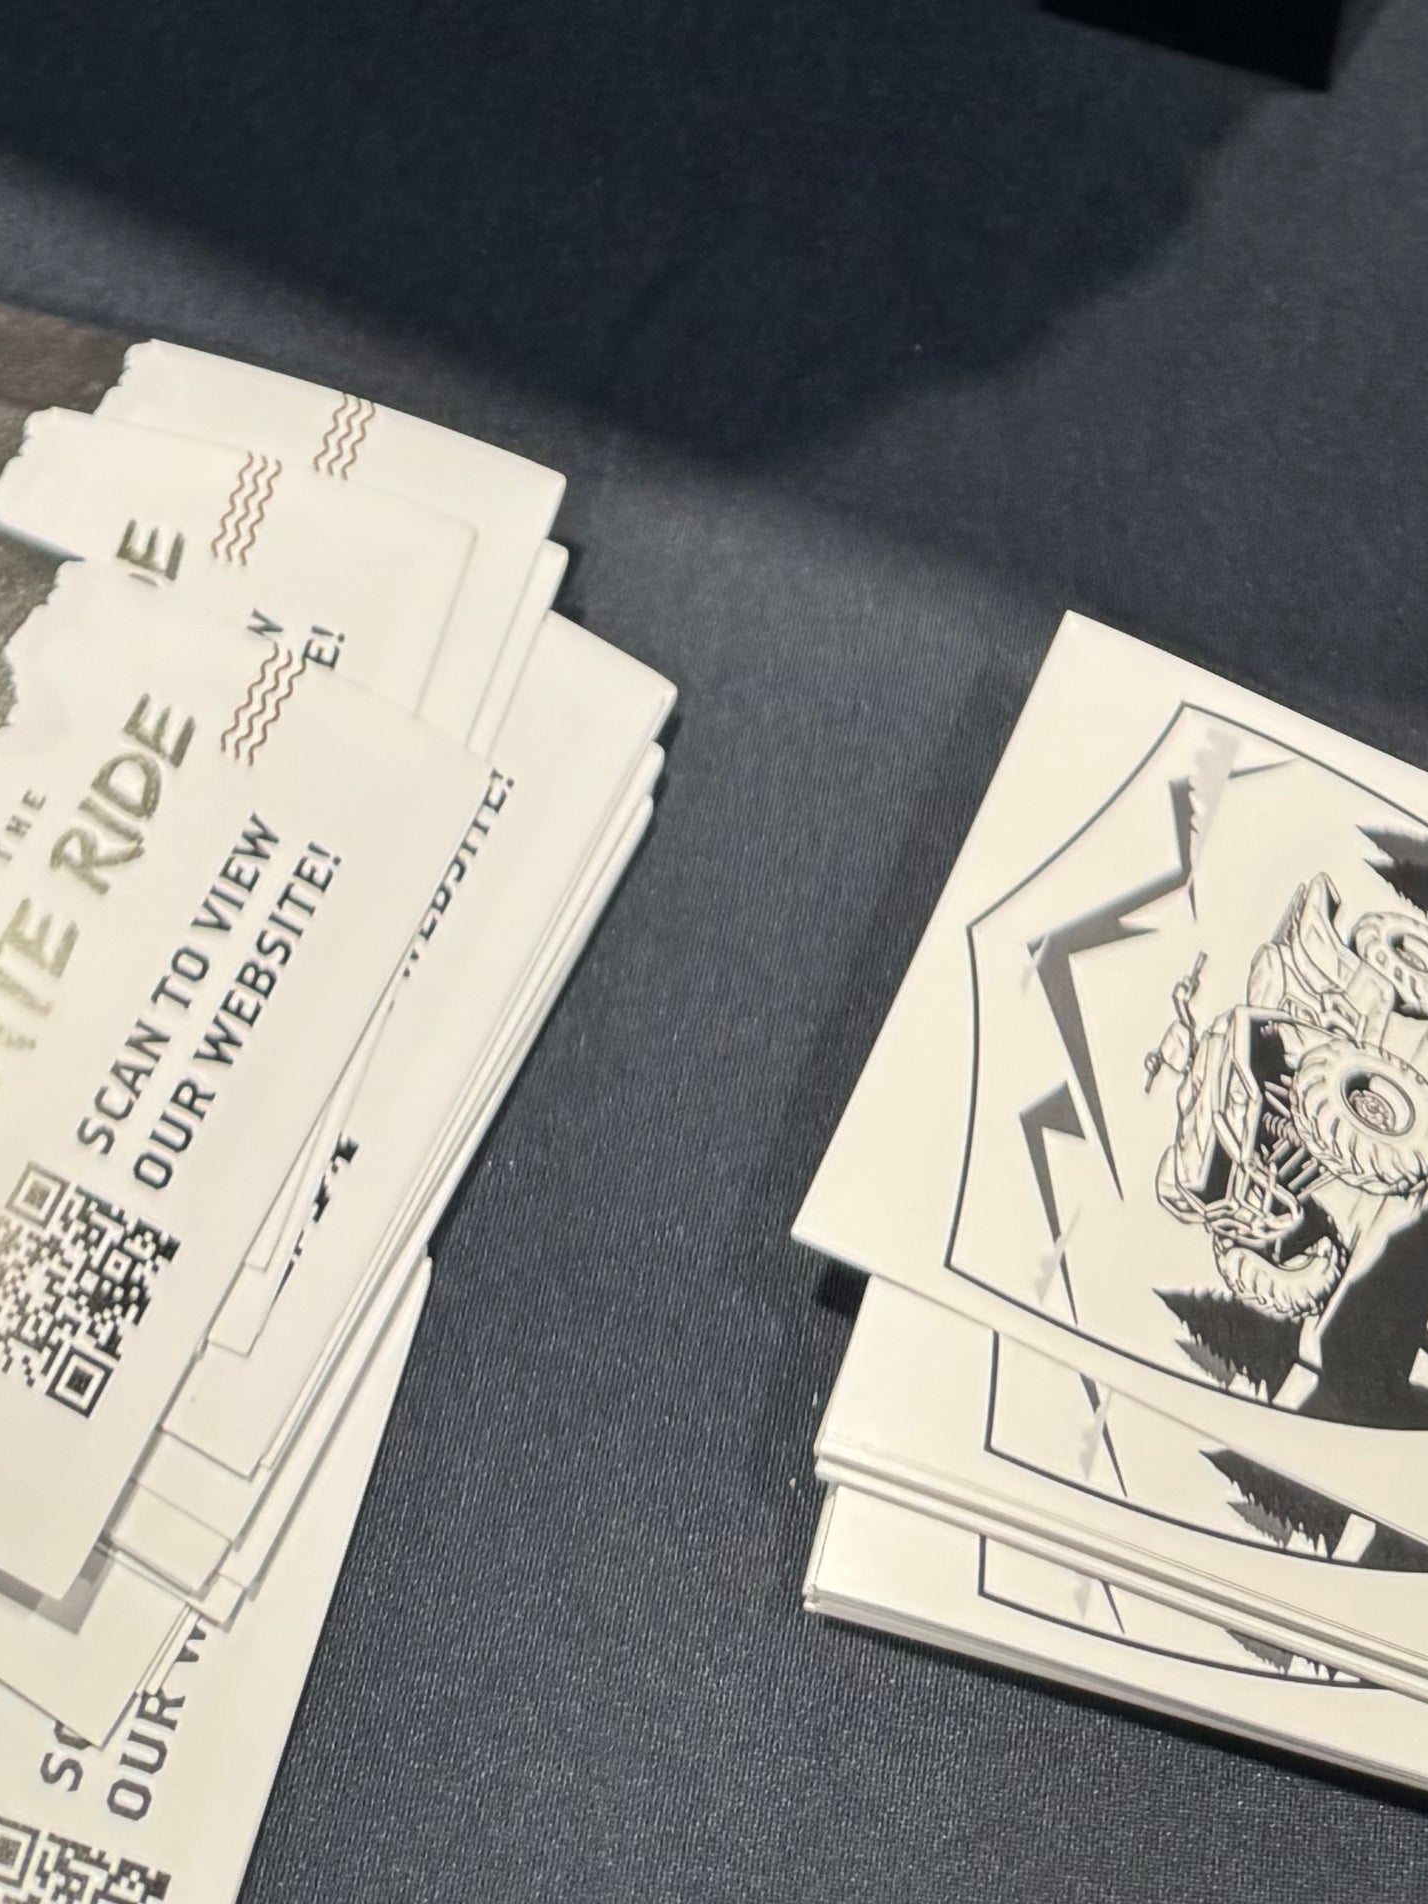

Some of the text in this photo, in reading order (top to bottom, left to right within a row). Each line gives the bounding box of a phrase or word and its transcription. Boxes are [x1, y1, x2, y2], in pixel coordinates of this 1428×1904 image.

[50, 693, 196, 896] RIDE
[77, 812, 280, 1156] SCAN TO VIEW
[132, 840, 341, 1190] OUR WEBSITE!
[107, 1689, 186, 1821] OUR
